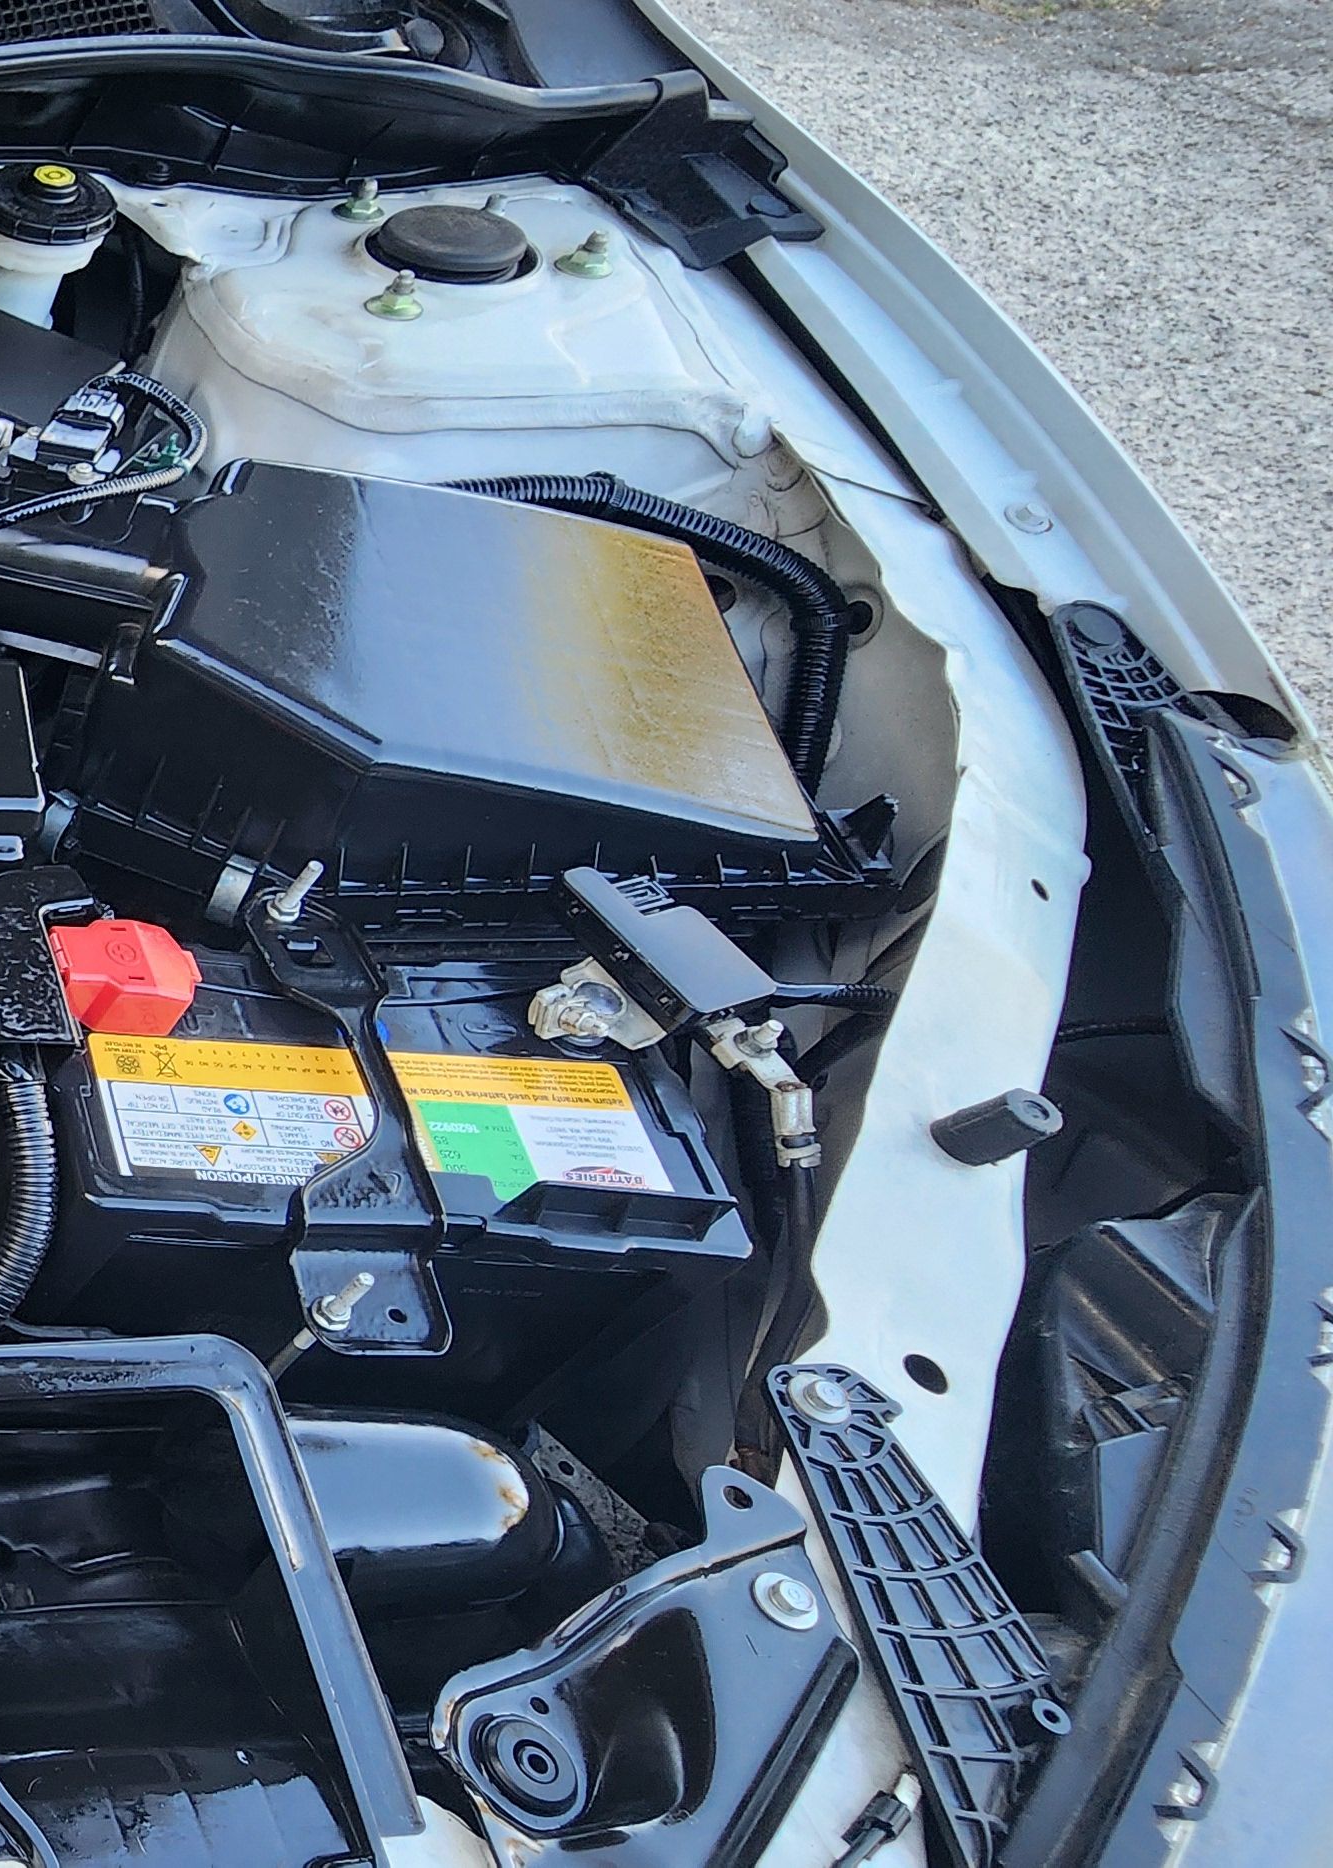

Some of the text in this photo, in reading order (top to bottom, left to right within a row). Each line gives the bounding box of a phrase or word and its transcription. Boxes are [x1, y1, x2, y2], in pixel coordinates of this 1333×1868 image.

[420, 1088, 451, 1097] Costco
[465, 1090, 506, 1101] batteries
[508, 1092, 530, 1101] used
[532, 1093, 549, 1102] and
[552, 1093, 591, 1104] warranty
[593, 1097, 623, 1107] Return
[433, 1135, 448, 1145] 85
[439, 1149, 461, 1159] 625
[196, 1169, 307, 1187] ANGER/POISON
[564, 1173, 643, 1185] BATTERIES
